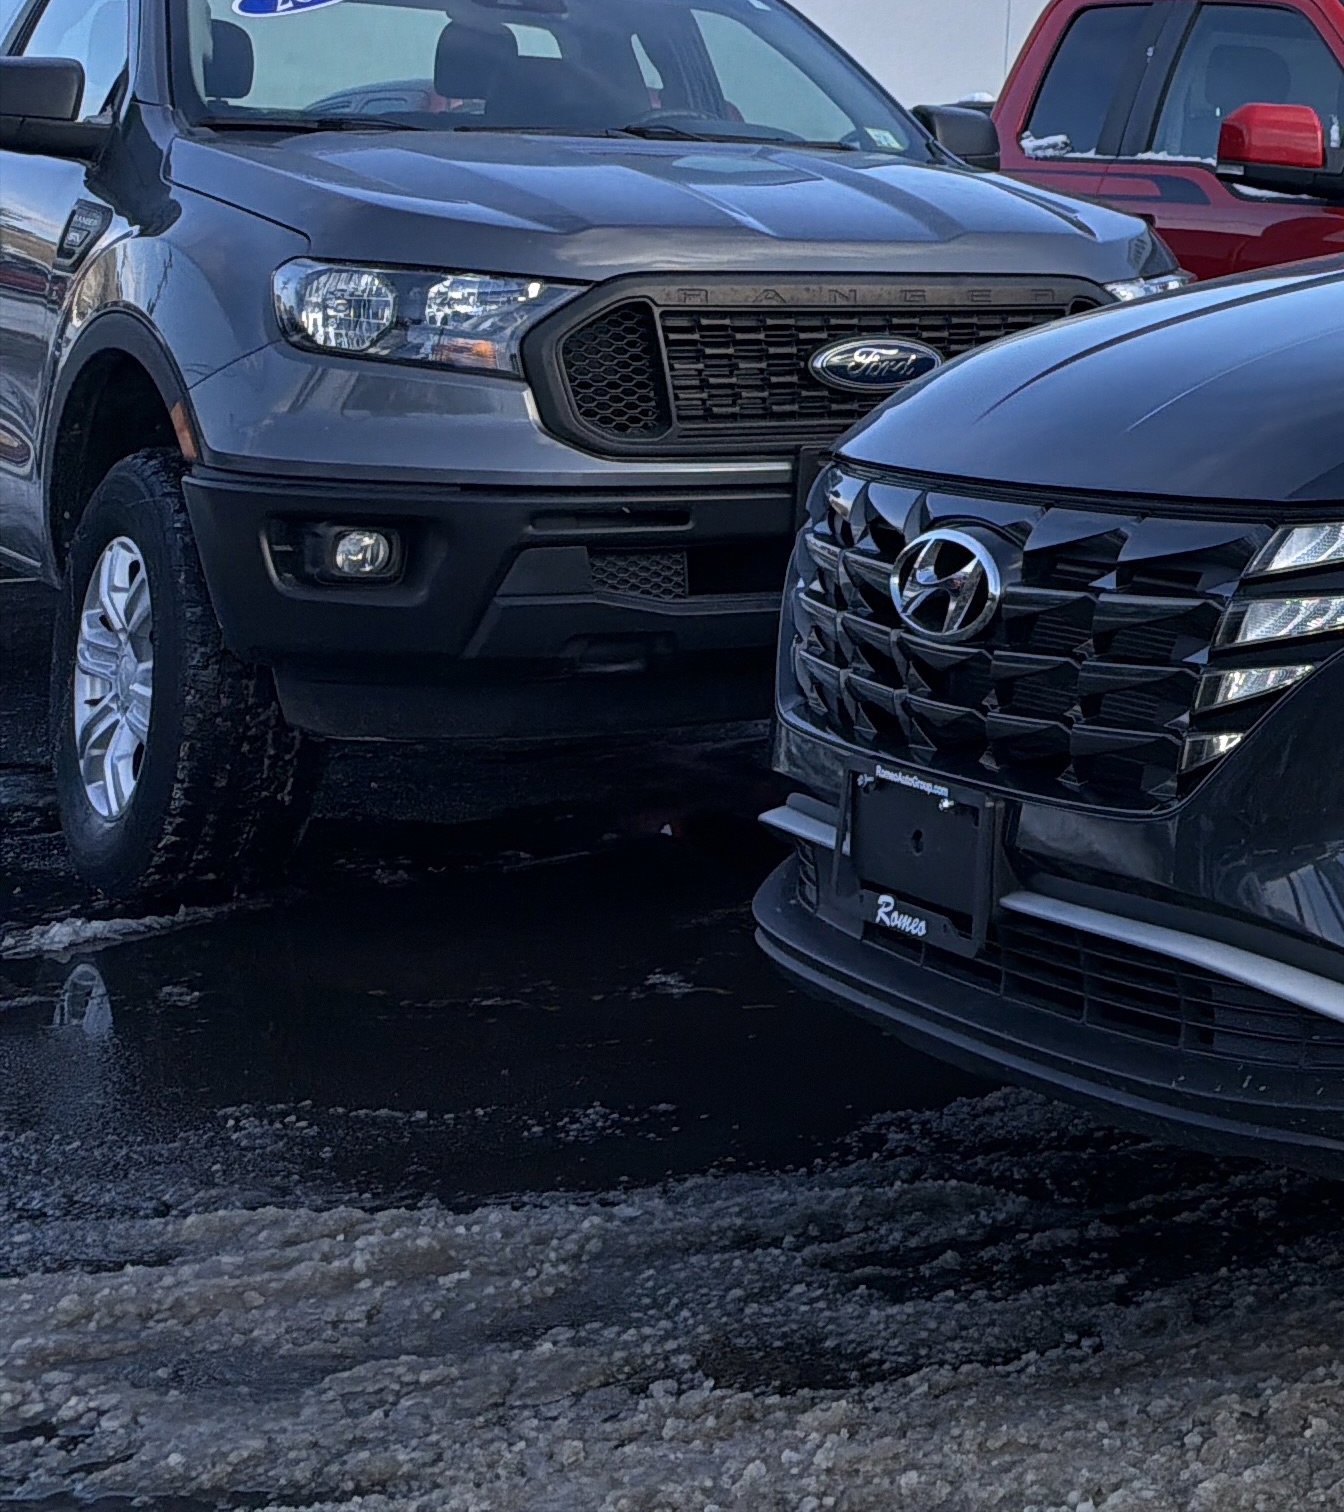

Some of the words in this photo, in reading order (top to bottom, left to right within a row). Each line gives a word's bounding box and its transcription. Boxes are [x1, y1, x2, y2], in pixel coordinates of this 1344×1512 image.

[677, 288, 1056, 304] RANGER
[847, 347, 917, 377] Ford
[875, 894, 927, 937] Romeo
